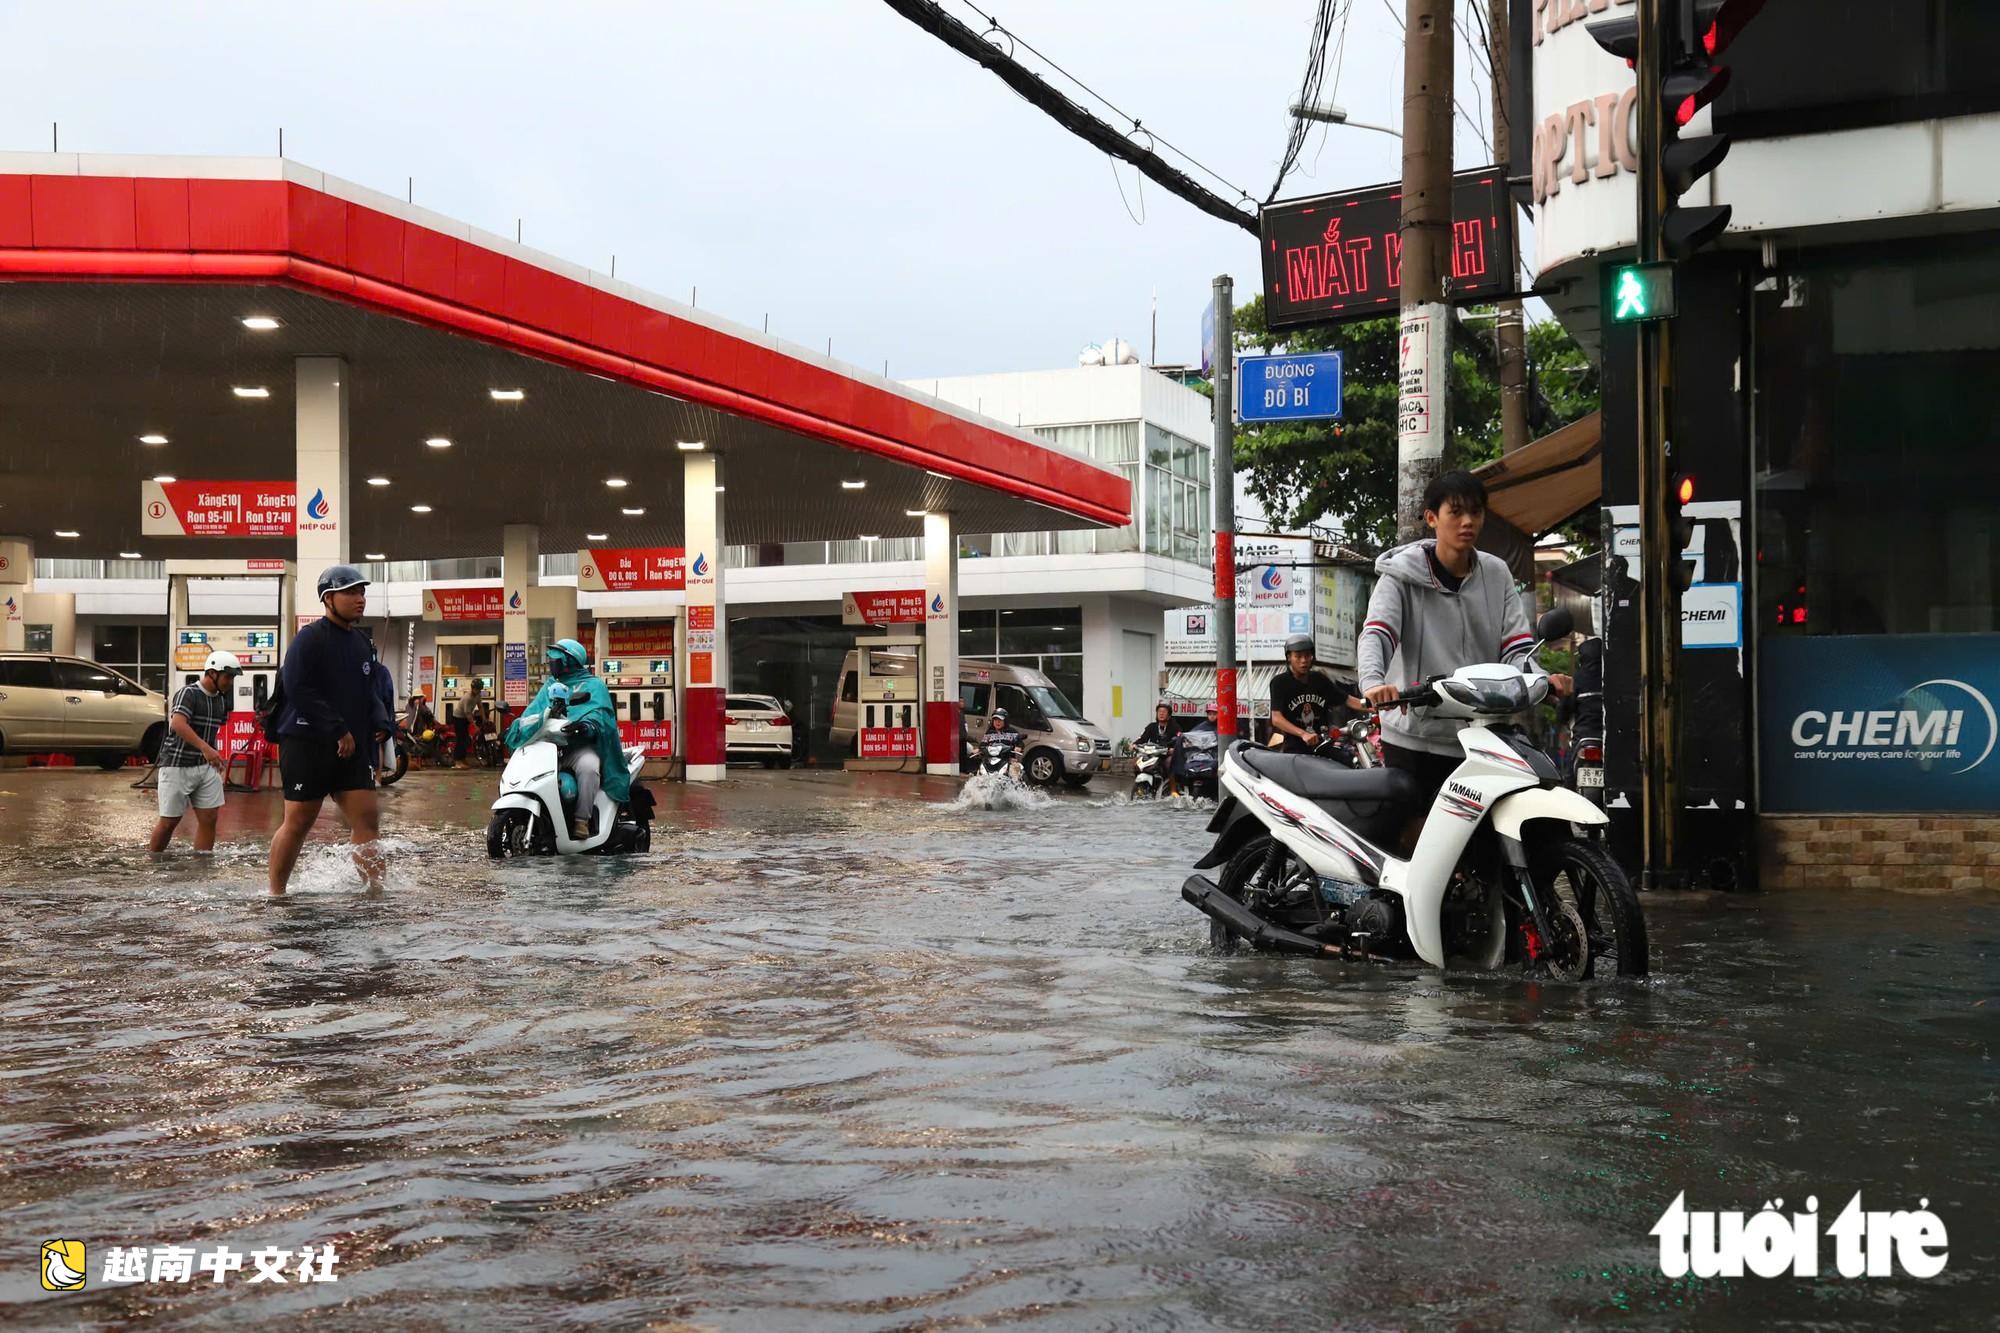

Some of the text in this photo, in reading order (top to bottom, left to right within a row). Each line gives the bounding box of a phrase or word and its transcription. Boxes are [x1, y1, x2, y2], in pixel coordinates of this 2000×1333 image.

[1286, 218, 1485, 302] MẮT KH
[1265, 361, 1314, 379] ĐƯỜNG
[1264, 381, 1312, 408] ĐỖ BÍ
[187, 511, 232, 524] Ron 95-III
[246, 512, 291, 524] Ron 97-III
[650, 570, 662, 580] Ron
[1680, 610, 1726, 621] CHEMI
[1792, 710, 1964, 747] CHEMI
[1817, 750, 1830, 758] for
[1832, 752, 1854, 760] your
[1920, 752, 1942, 760] your
[1945, 750, 1961, 759] life
[1448, 781, 1482, 803] YAMAHA
